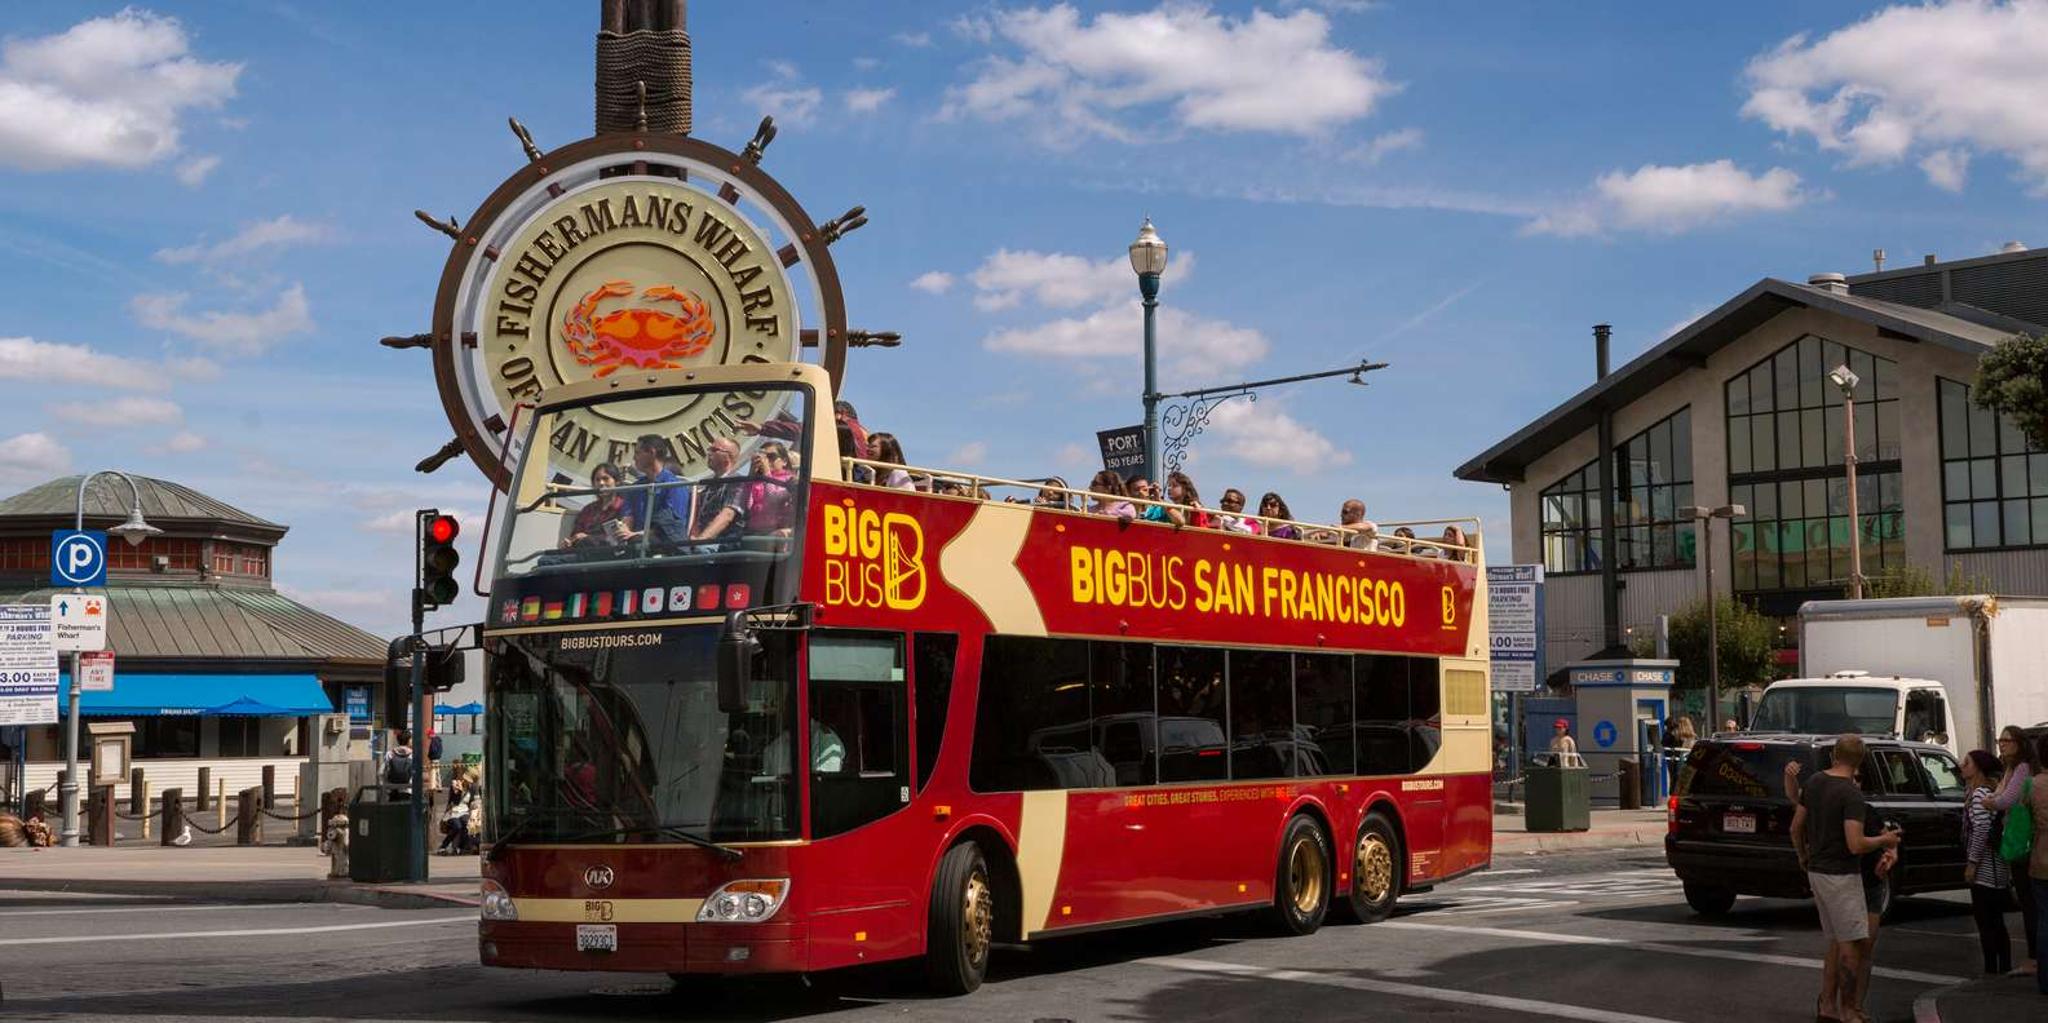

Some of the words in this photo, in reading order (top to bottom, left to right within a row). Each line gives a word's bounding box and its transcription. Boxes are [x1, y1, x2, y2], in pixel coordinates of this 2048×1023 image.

[496, 194, 694, 340] FISHERMANS
[693, 211, 780, 337] WHARF
[500, 356, 545, 402] OF
[550, 412, 600, 463] AN
[1108, 434, 1137, 452] PORT
[1120, 454, 1145, 466] YEARS
[824, 503, 881, 559] BIG
[69, 543, 93, 574] P
[826, 559, 883, 608] BUS
[1195, 559, 1255, 616] SAN
[1263, 567, 1405, 628] FRANCISCO
[6, 633, 43, 641] PARKING
[561, 632, 662, 650] BIGBUSTOURS.COM
[1577, 671, 1614, 682] CHASE
[1636, 671, 1664, 682] CHASE
